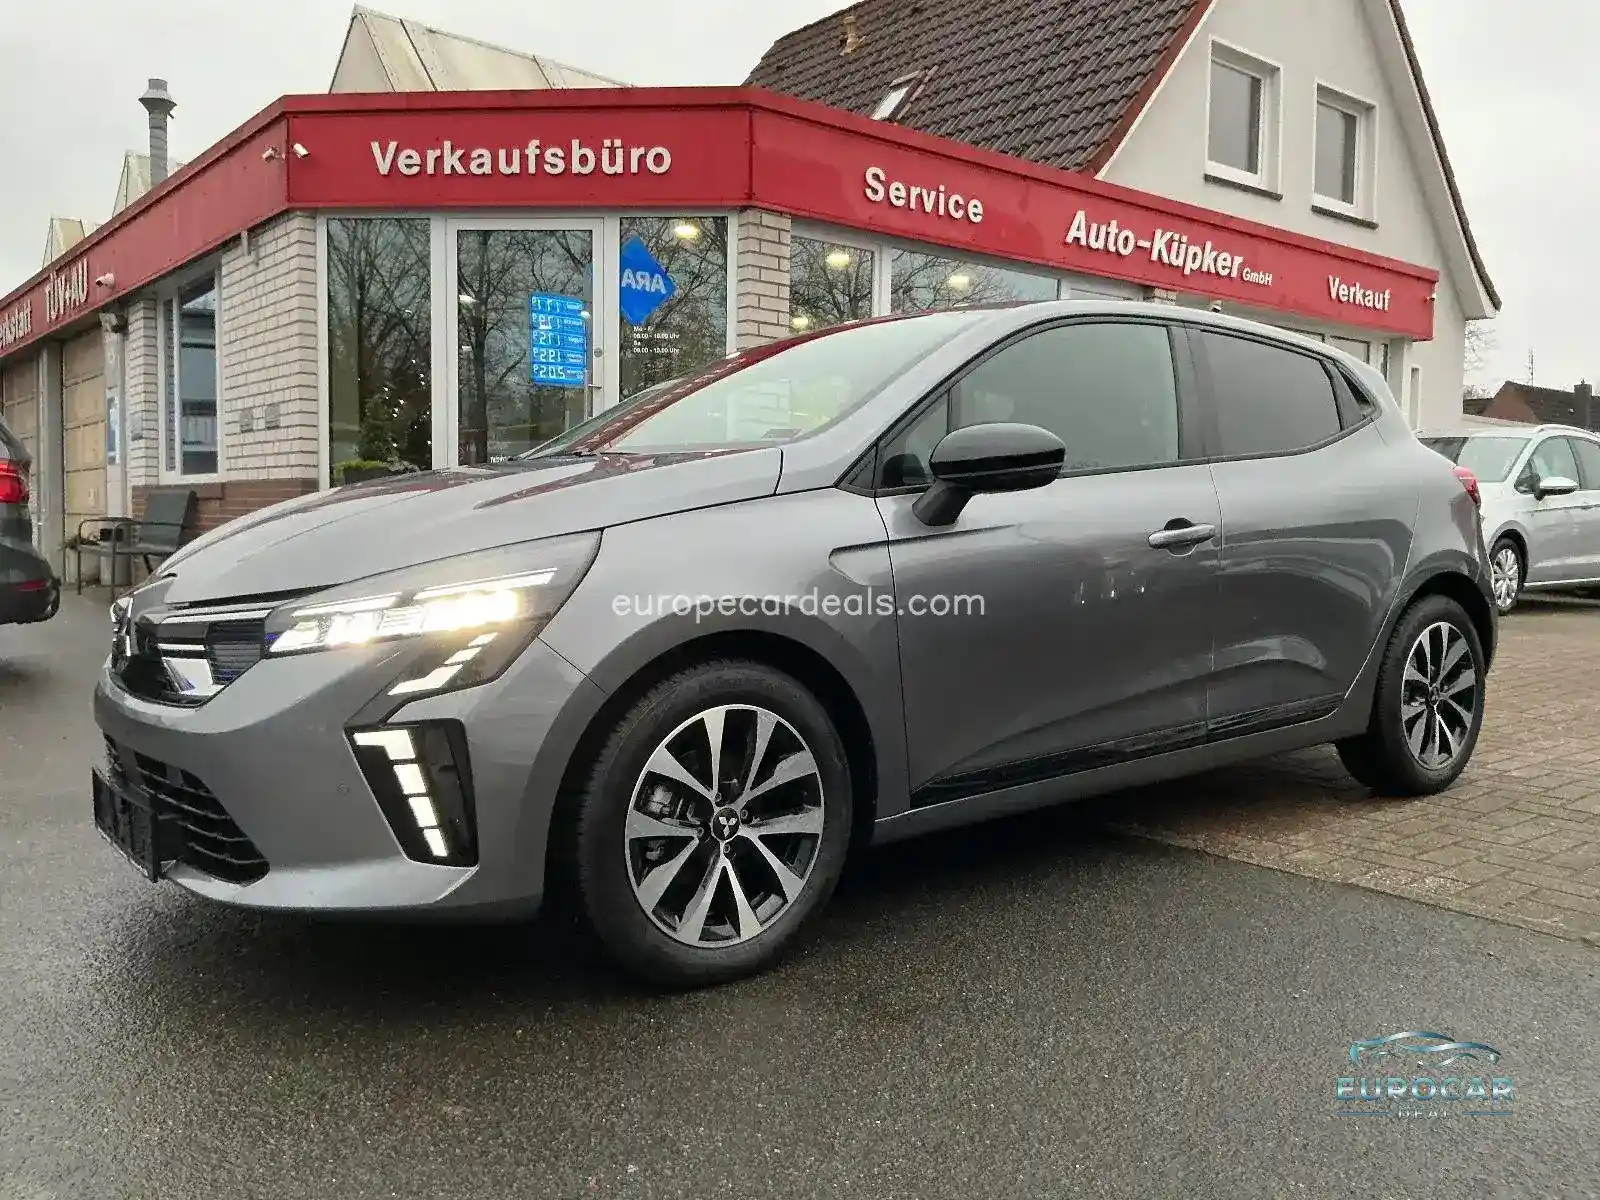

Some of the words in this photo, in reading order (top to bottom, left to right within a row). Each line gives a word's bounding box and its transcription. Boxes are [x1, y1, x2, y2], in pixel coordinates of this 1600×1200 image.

[370, 138, 672, 176] Verkaufsbüro
[864, 166, 985, 224] Service
[1065, 209, 1243, 281] Auto-Küpker
[1242, 267, 1273, 286] GmbH
[1328, 275, 1391, 312] Verkauf
